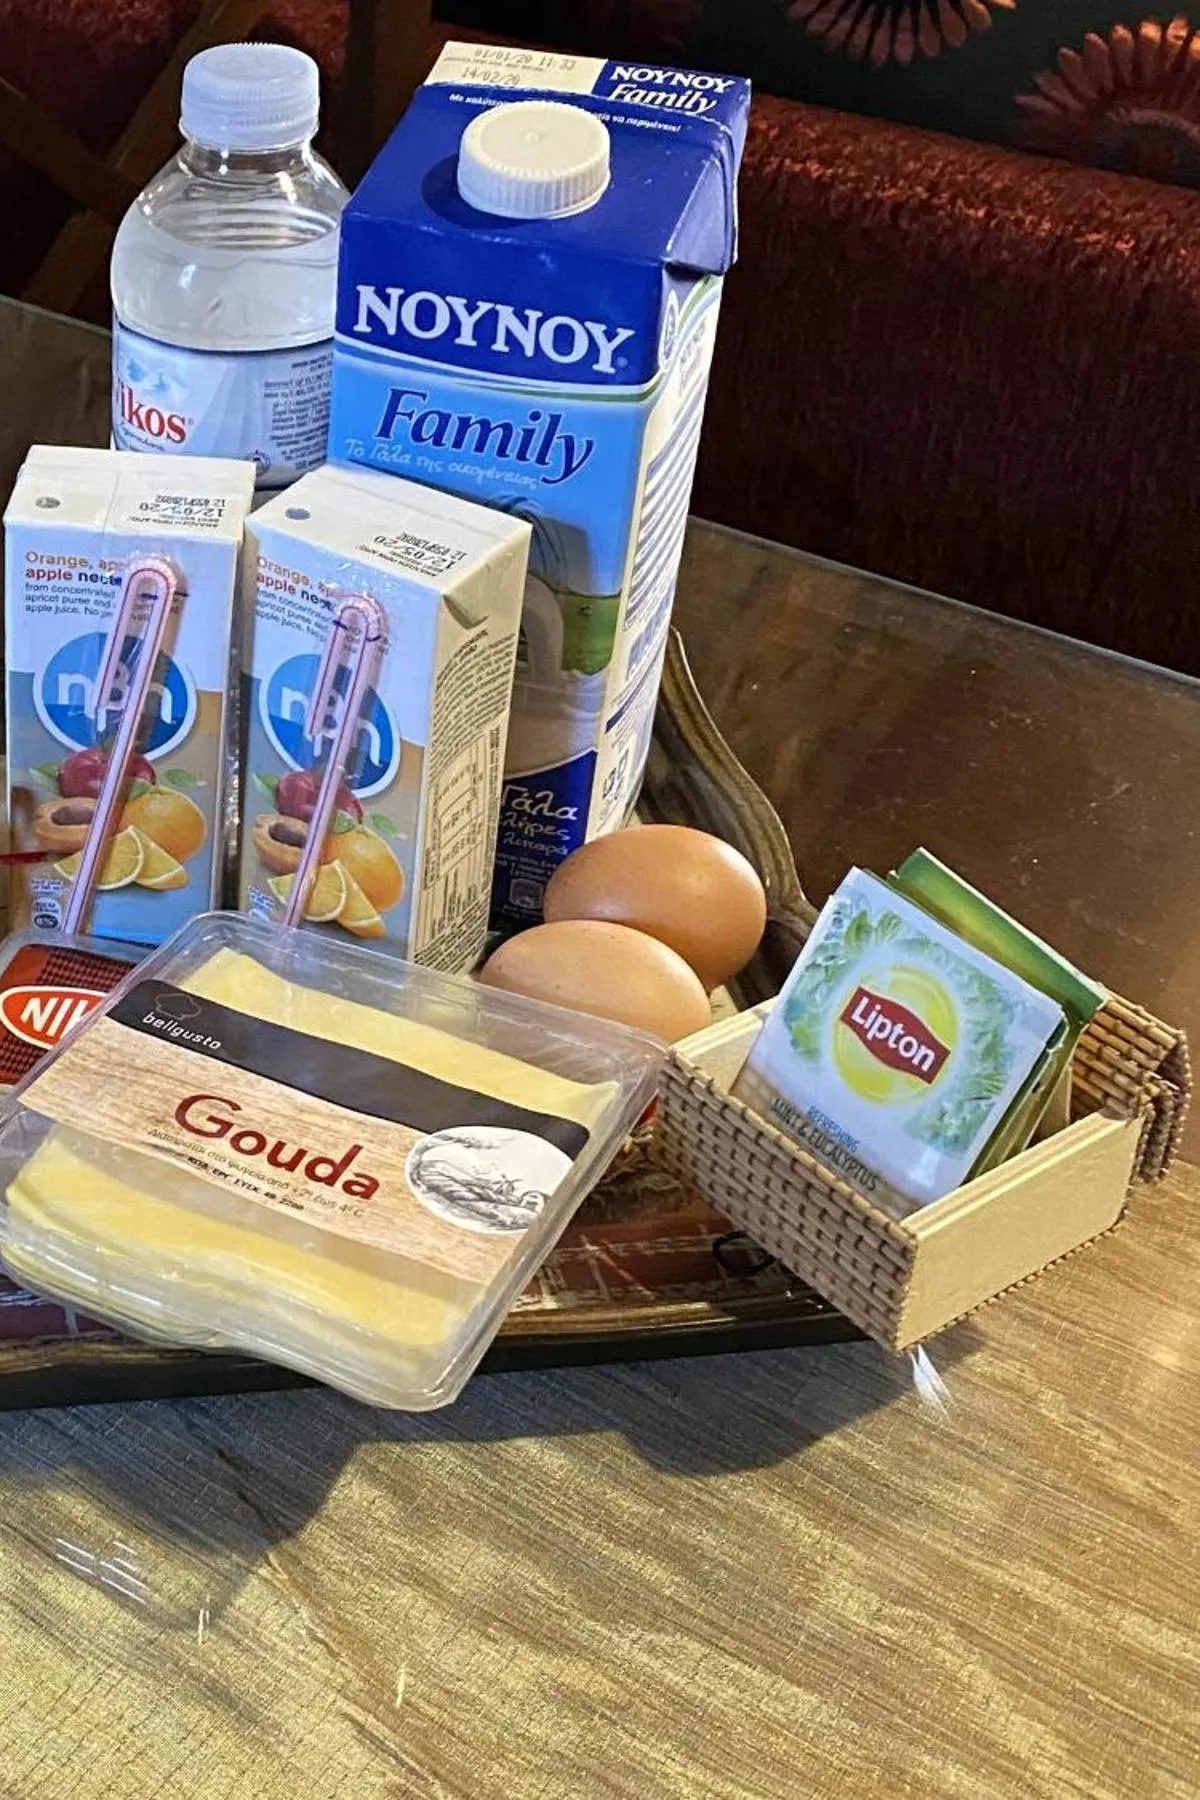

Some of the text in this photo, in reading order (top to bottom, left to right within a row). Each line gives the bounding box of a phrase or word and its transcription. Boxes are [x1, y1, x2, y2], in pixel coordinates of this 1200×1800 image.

[610, 66, 736, 94] NOYNOY
[608, 84, 718, 115] Family
[352, 284, 635, 374] NOYNOY
[375, 388, 596, 485] Family
[344, 438, 365, 458] Το
[369, 442, 412, 467] Γάλα
[416, 455, 444, 474] της
[25, 568, 73, 582] apple
[26, 551, 93, 570] Orange,
[25, 582, 49, 592] from
[257, 573, 297, 595] apple
[502, 784, 579, 820] Γάλα
[849, 994, 938, 1075] Lipton
[174, 1093, 381, 1201] Gouda
[808, 1128, 880, 1192] EUCALYPTUS
